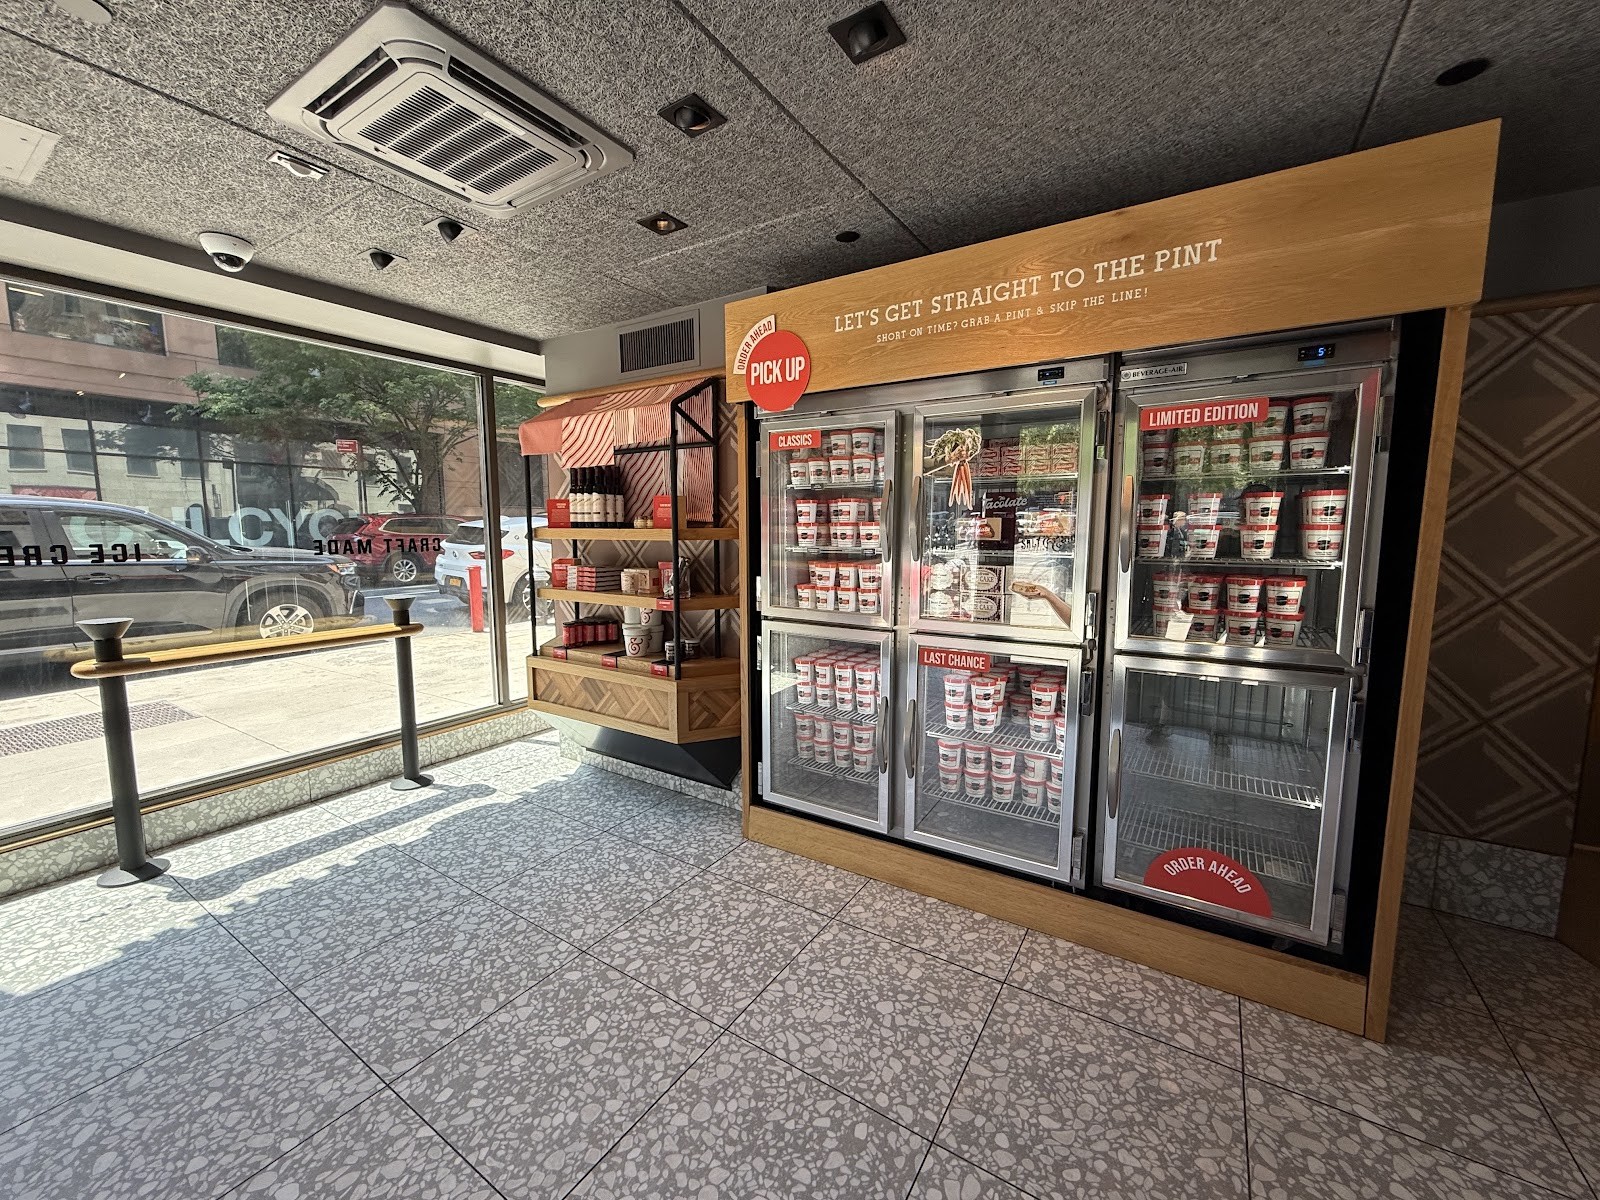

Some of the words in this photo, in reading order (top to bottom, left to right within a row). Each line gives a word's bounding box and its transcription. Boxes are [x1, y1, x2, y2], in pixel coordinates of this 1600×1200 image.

[834, 308, 879, 333] LET'S
[885, 299, 923, 323] GET
[931, 275, 1042, 315] STRAIGHT
[1050, 267, 1085, 292] TO
[1093, 254, 1145, 284] THE
[1154, 238, 1223, 273] PINT
[876, 330, 907, 343] SHORT
[909, 327, 923, 337] ON
[927, 321, 958, 334] TIME?
[961, 315, 990, 329] GRAB
[993, 313, 1001, 323] A
[1006, 308, 1031, 321] PINT
[1036, 306, 1044, 316] &
[1049, 300, 1078, 314] SKIP
[1082, 295, 1105, 308] THE
[1111, 287, 1149, 303] LINE!
[737, 340, 753, 371] ORDER
[749, 320, 773, 344] AHEAD
[750, 358, 783, 386] PICK
[785, 356, 806, 382] UP
[1149, 407, 1201, 427] LIMITED
[1203, 402, 1259, 423] EDITION
[778, 433, 813, 448] CLASSICS
[923, 651, 947, 665] LAST
[948, 654, 986, 670] CHANCE
[1163, 856, 1205, 876] ORDER
[1208, 860, 1252, 894] AHEAD
